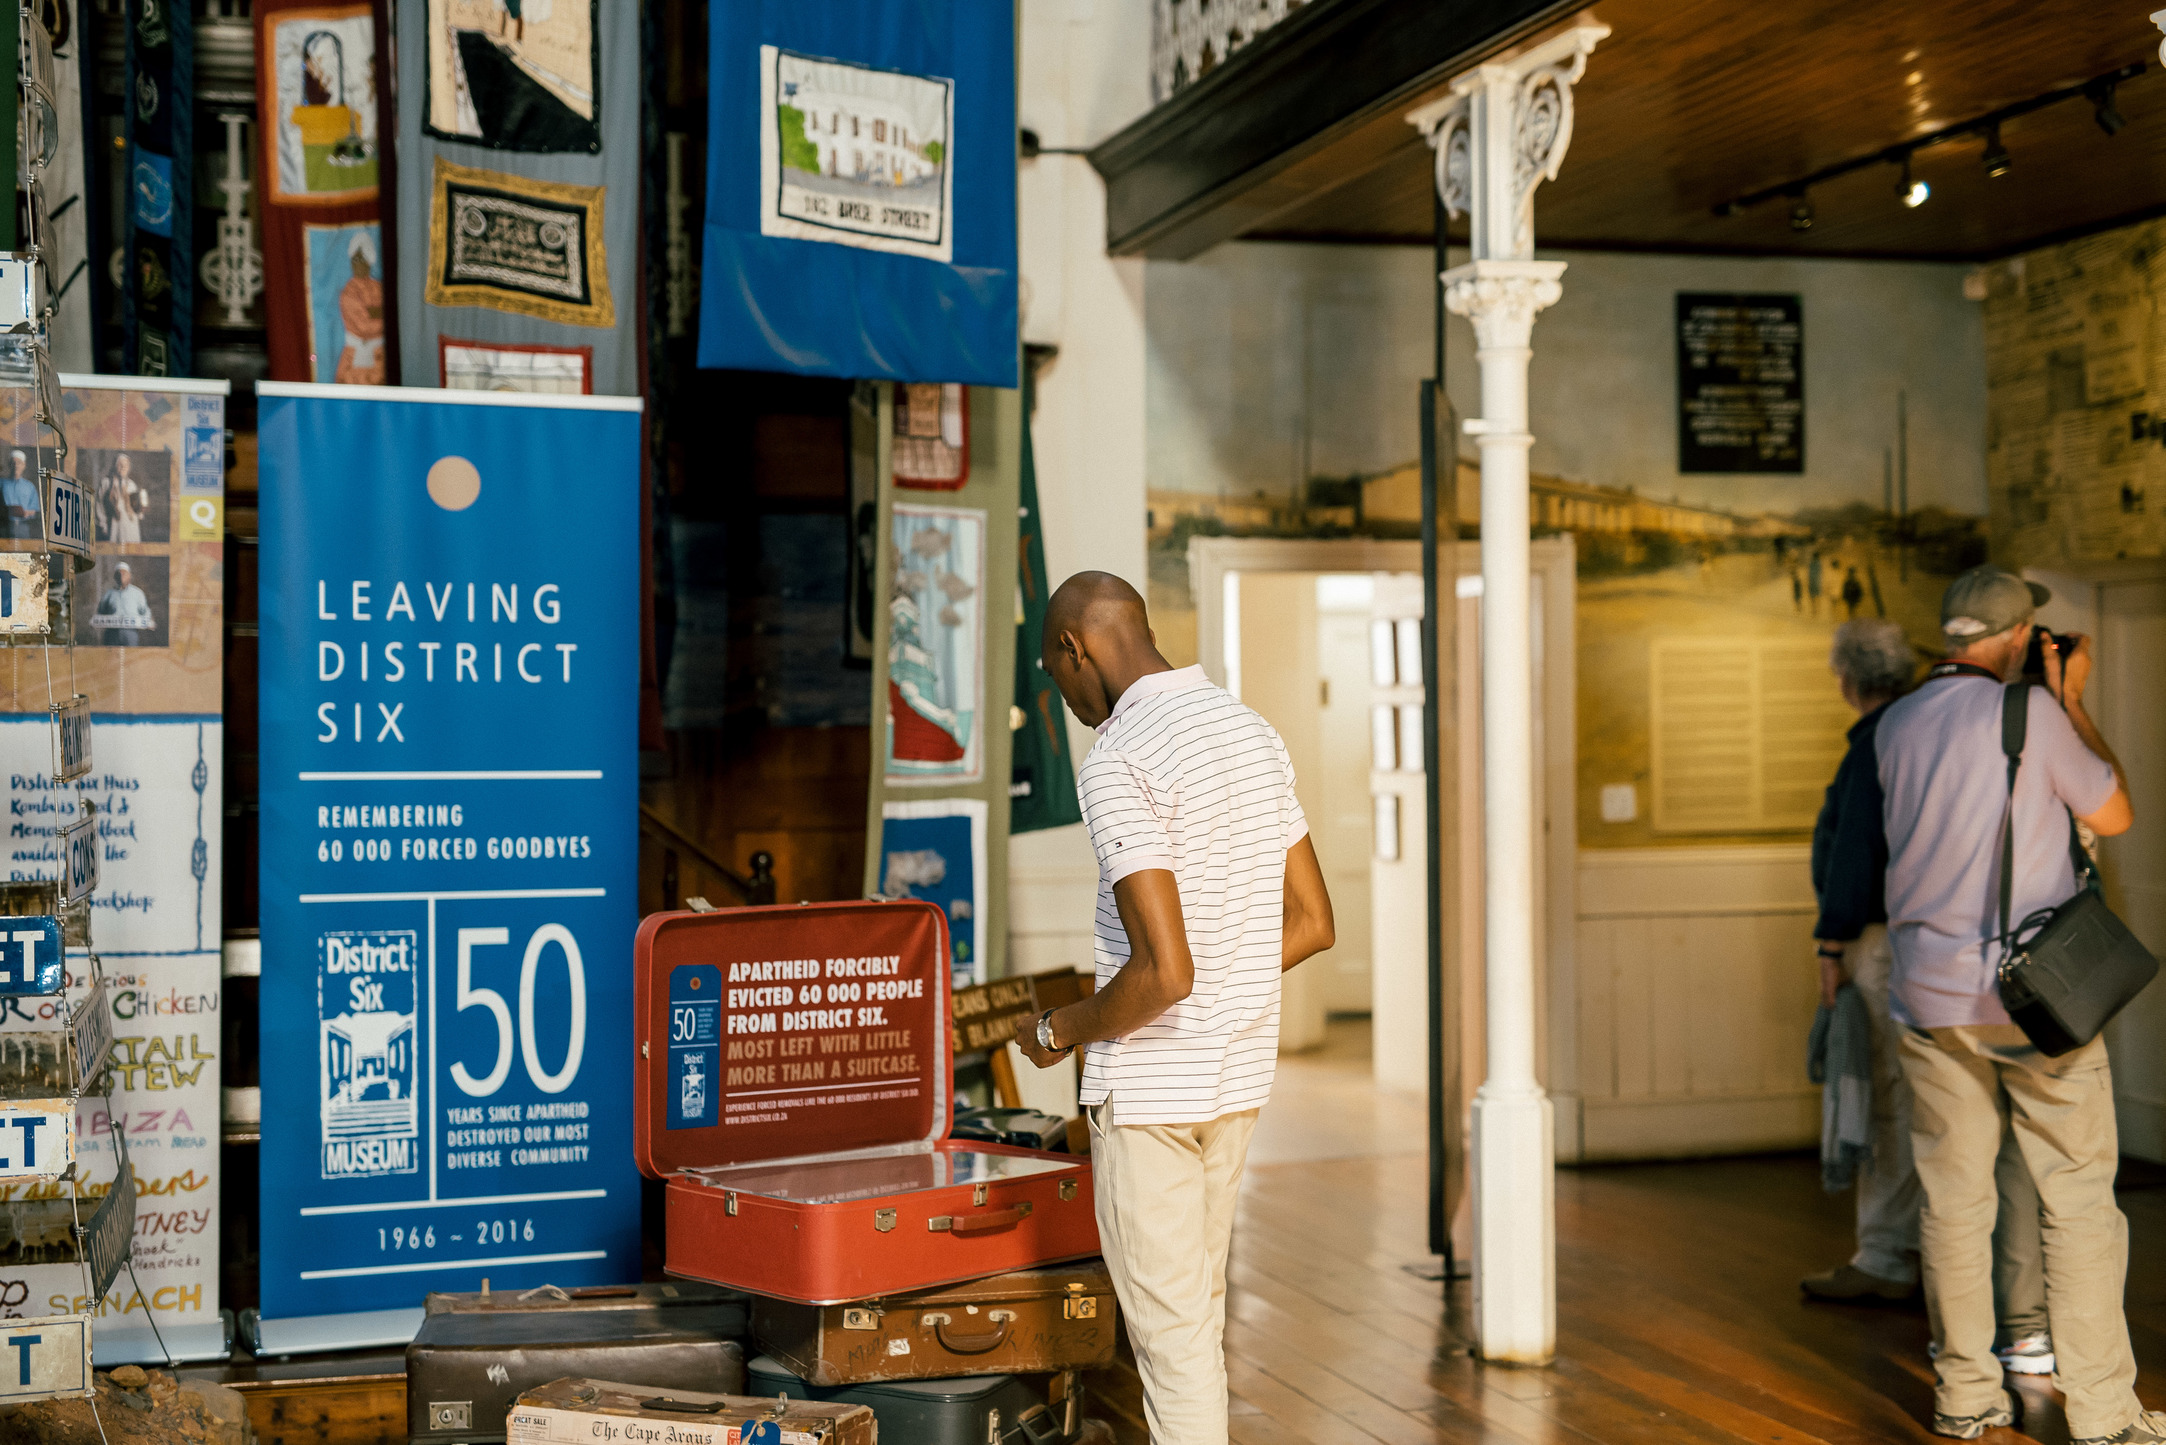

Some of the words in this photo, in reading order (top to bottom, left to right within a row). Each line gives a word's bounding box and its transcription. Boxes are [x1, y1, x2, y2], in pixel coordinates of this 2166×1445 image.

[318, 579, 561, 624] LEAVING
[318, 640, 578, 683] DISTRICT
[317, 702, 405, 743] SIX
[104, 775, 139, 790] Huis
[318, 804, 463, 829] REMEMBERING
[318, 840, 343, 862] 60
[353, 838, 391, 861] 000
[402, 837, 477, 861] FORCED
[487, 835, 591, 860] GOODBYES
[326, 936, 410, 975] District
[728, 959, 820, 983] APARTHEID
[825, 955, 900, 978] FORCIBLY
[349, 975, 385, 1012] Six
[728, 987, 794, 1009] EVICTED
[799, 984, 822, 1004] 60
[827, 982, 861, 1003] 000
[866, 979, 923, 1001] PEOPLE
[449, 922, 588, 1098] 50
[673, 1008, 696, 1041] 50
[727, 1013, 777, 1035] FROM
[782, 1009, 853, 1032] DISTRICT
[857, 1006, 888, 1027] SIX.
[727, 1039, 774, 1061] MOST
[780, 1037, 813, 1058] LEFT
[819, 1033, 860, 1055] WITH
[865, 1030, 910, 1052] LITTLE
[726, 1066, 776, 1087] MORE
[782, 1061, 825, 1082] THAN
[830, 1060, 841, 1079] A
[847, 1054, 920, 1077] SUITCASE.
[75, 1107, 193, 1137] BIZA
[447, 1107, 484, 1125] YEARS
[488, 1104, 522, 1123] SINCE
[526, 1101, 589, 1121] APARTHEID
[447, 1127, 521, 1147] DESTROYED
[524, 1125, 551, 1143] OUR
[554, 1122, 589, 1141] MOST
[326, 1138, 409, 1173] MUSEUM
[447, 1150, 501, 1169] DIVERSE
[510, 1145, 589, 1166] COMMUNITY
[133, 1207, 210, 1237] TNEY
[377, 1225, 436, 1251] 1966
[476, 1218, 535, 1245] 2016
[592, 1421, 619, 1441] The
[625, 1423, 660, 1445] Cape
